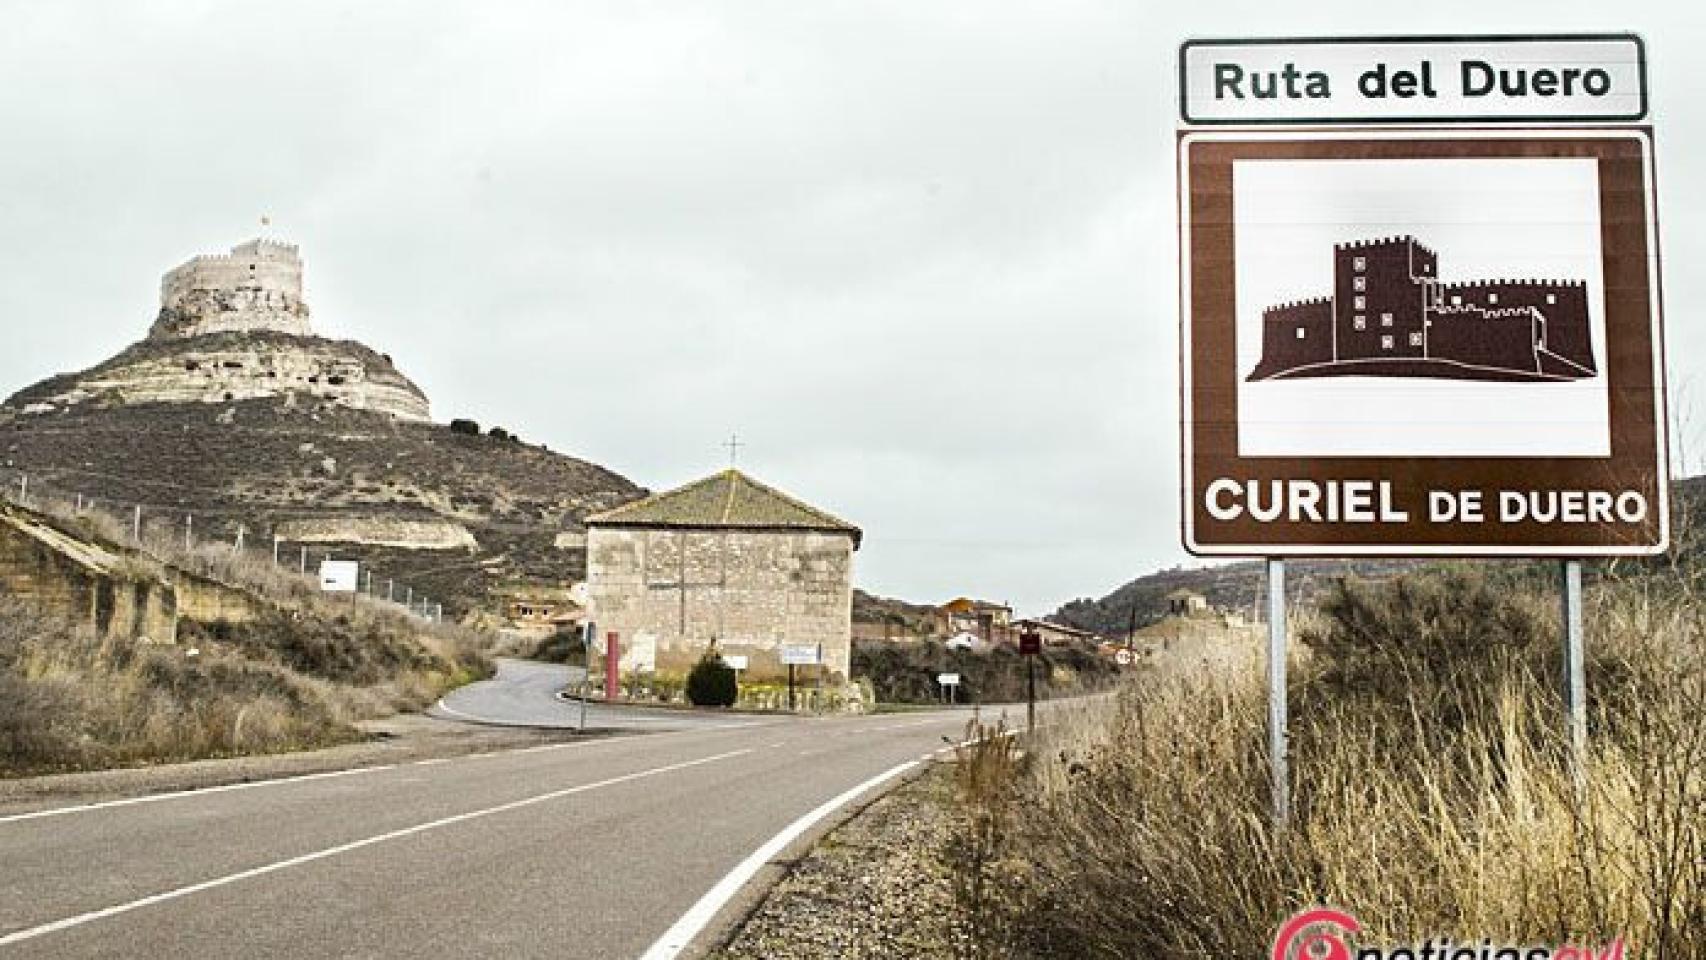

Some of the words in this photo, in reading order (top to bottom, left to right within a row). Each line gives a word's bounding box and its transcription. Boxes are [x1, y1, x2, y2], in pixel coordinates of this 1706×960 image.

[1214, 63, 1331, 99] Ruta
[1357, 62, 1436, 98] del
[1461, 60, 1611, 97] Duero
[1205, 477, 1408, 521] CURIEL
[1430, 491, 1484, 522] DE
[1500, 491, 1648, 522] DUERO
